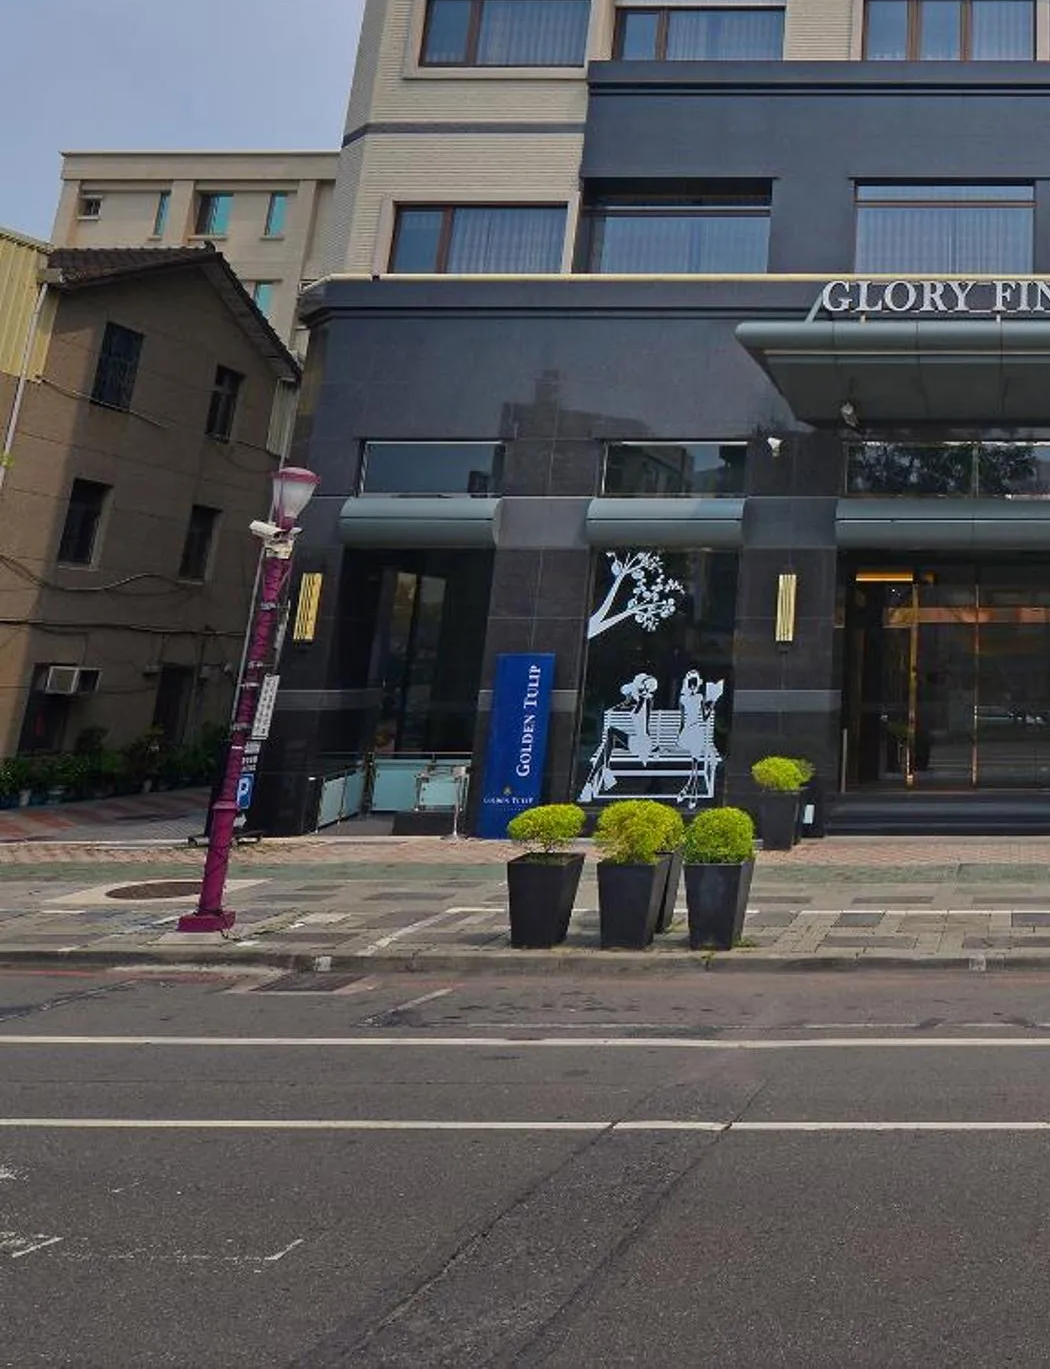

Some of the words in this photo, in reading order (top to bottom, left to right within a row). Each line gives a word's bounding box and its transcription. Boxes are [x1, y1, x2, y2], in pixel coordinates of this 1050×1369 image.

[822, 280, 975, 312] GLORY
[523, 665, 541, 709] TULIP
[516, 714, 536, 777] GOLDEN
